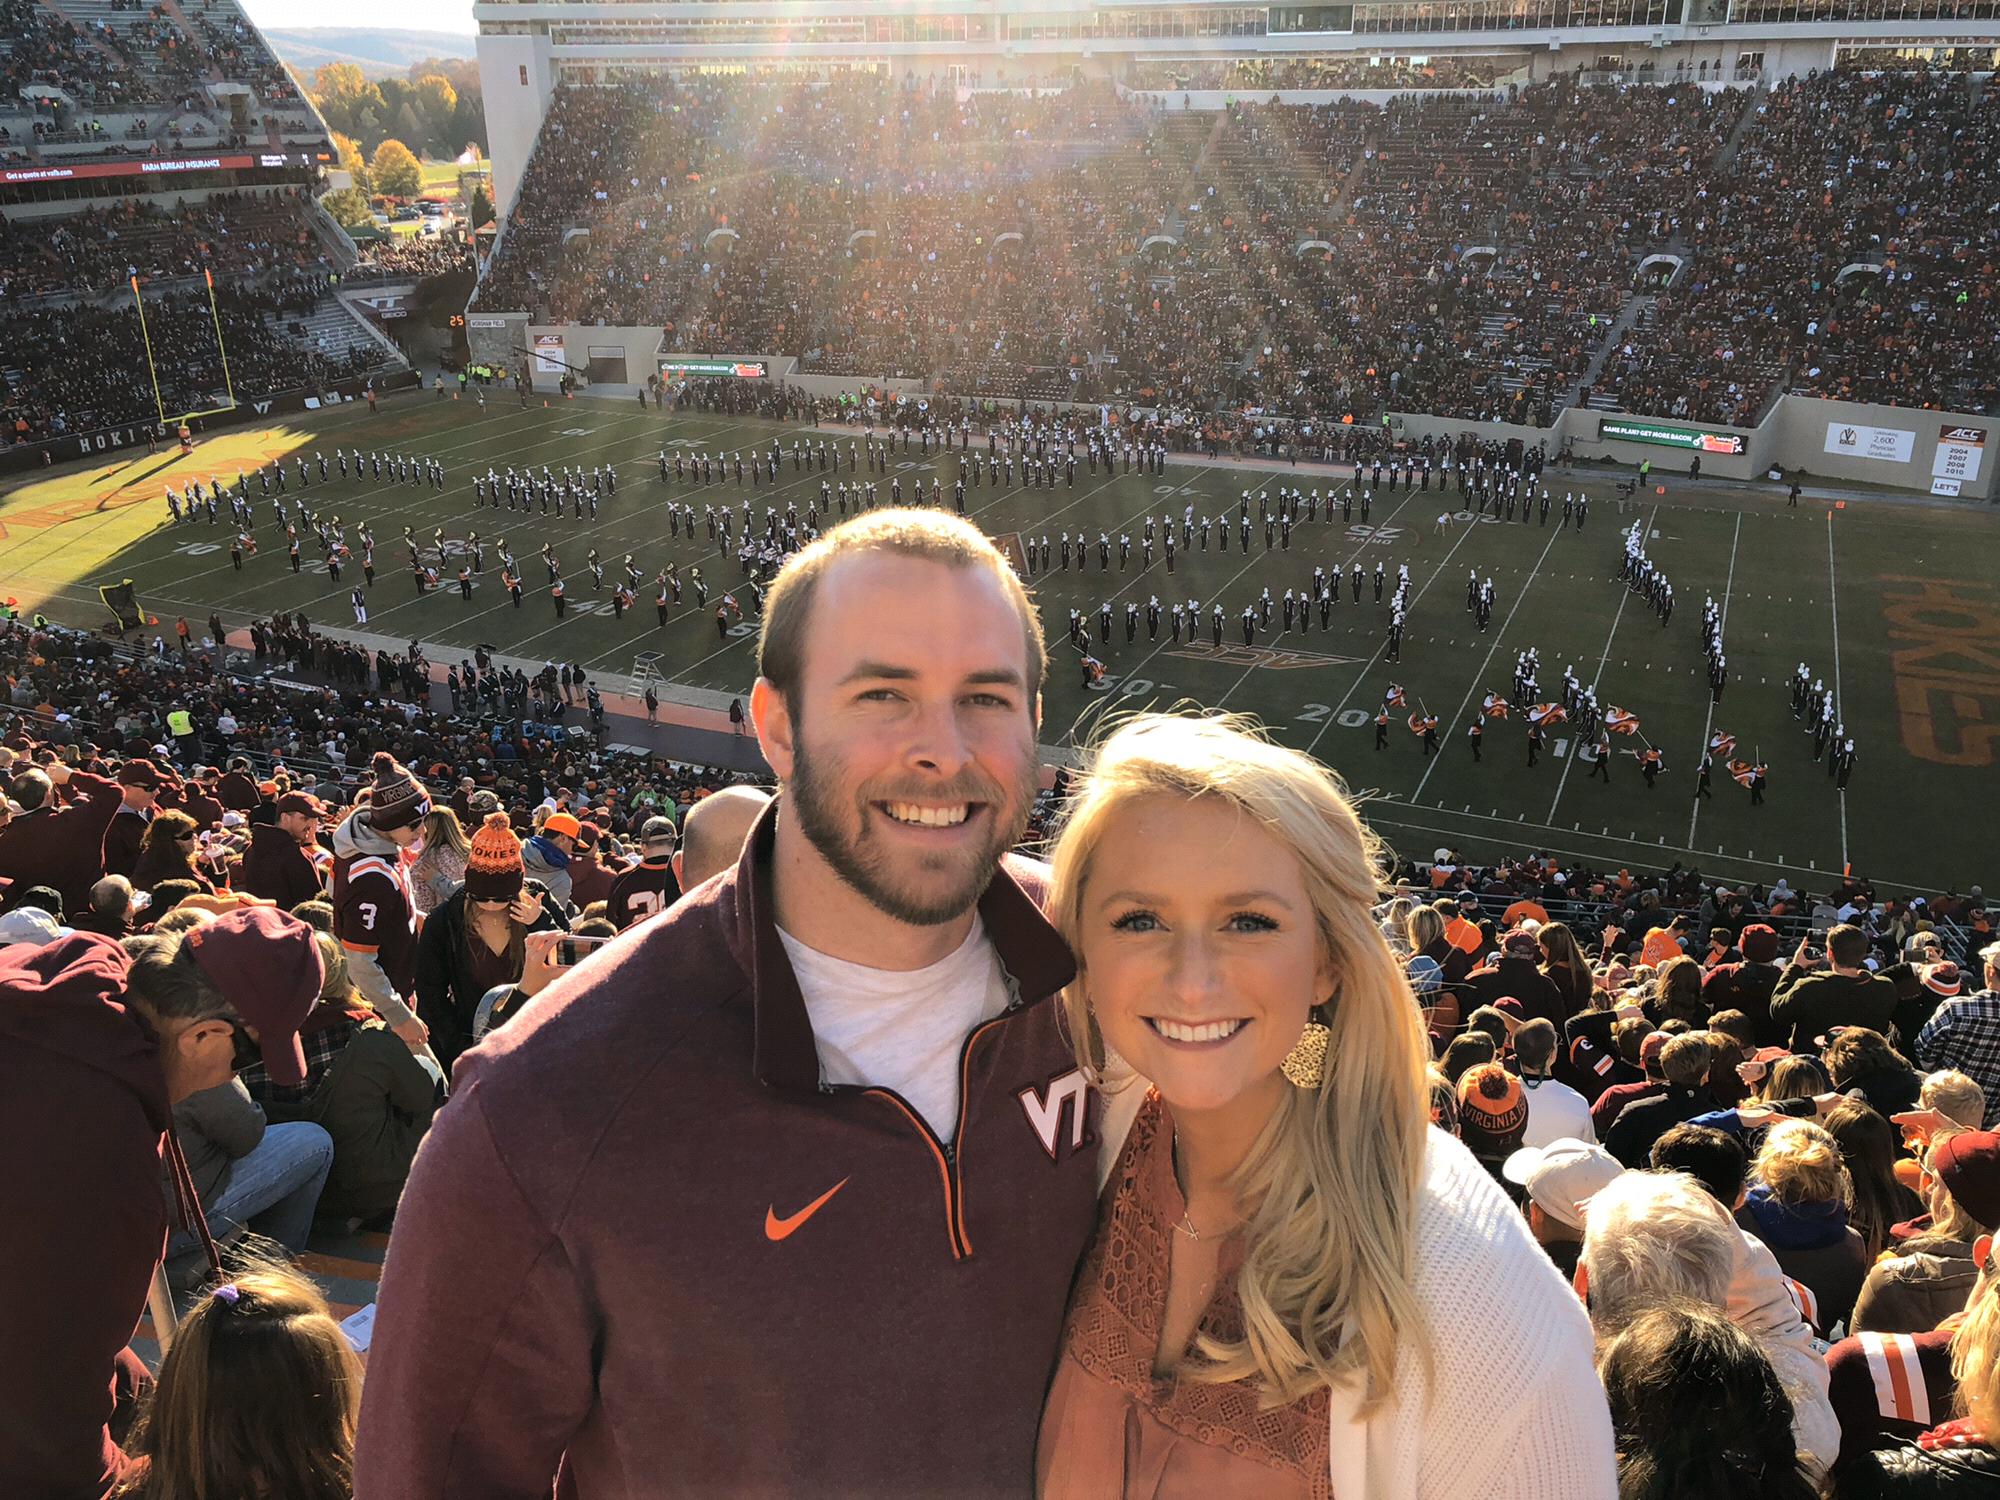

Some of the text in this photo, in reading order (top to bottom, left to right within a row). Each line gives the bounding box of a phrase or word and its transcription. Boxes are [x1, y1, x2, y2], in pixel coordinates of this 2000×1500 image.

[142, 159, 220, 172] FARM BUREAU INSURANCE
[6, 172, 17, 180] Get
[23, 171, 40, 180] quote
[450, 315, 464, 327] 25
[538, 335, 560, 344] ACC
[252, 400, 273, 414] VT
[1603, 425, 1693, 442] GAME PLAN? GET MORE BACON
[1873, 436, 1896, 445] 2,600
[1945, 428, 1982, 441] ACC
[1945, 467, 1964, 475] 2010
[1934, 482, 1959, 492] LET'S
[172, 542, 222, 556] 10
[726, 622, 761, 637] 5
[1294, 703, 1371, 728] 20
[627, 889, 666, 922] 2
[359, 902, 378, 930] 3
[1018, 1066, 1095, 1160] VT
[1464, 1104, 1518, 1129] VIRGINIA
